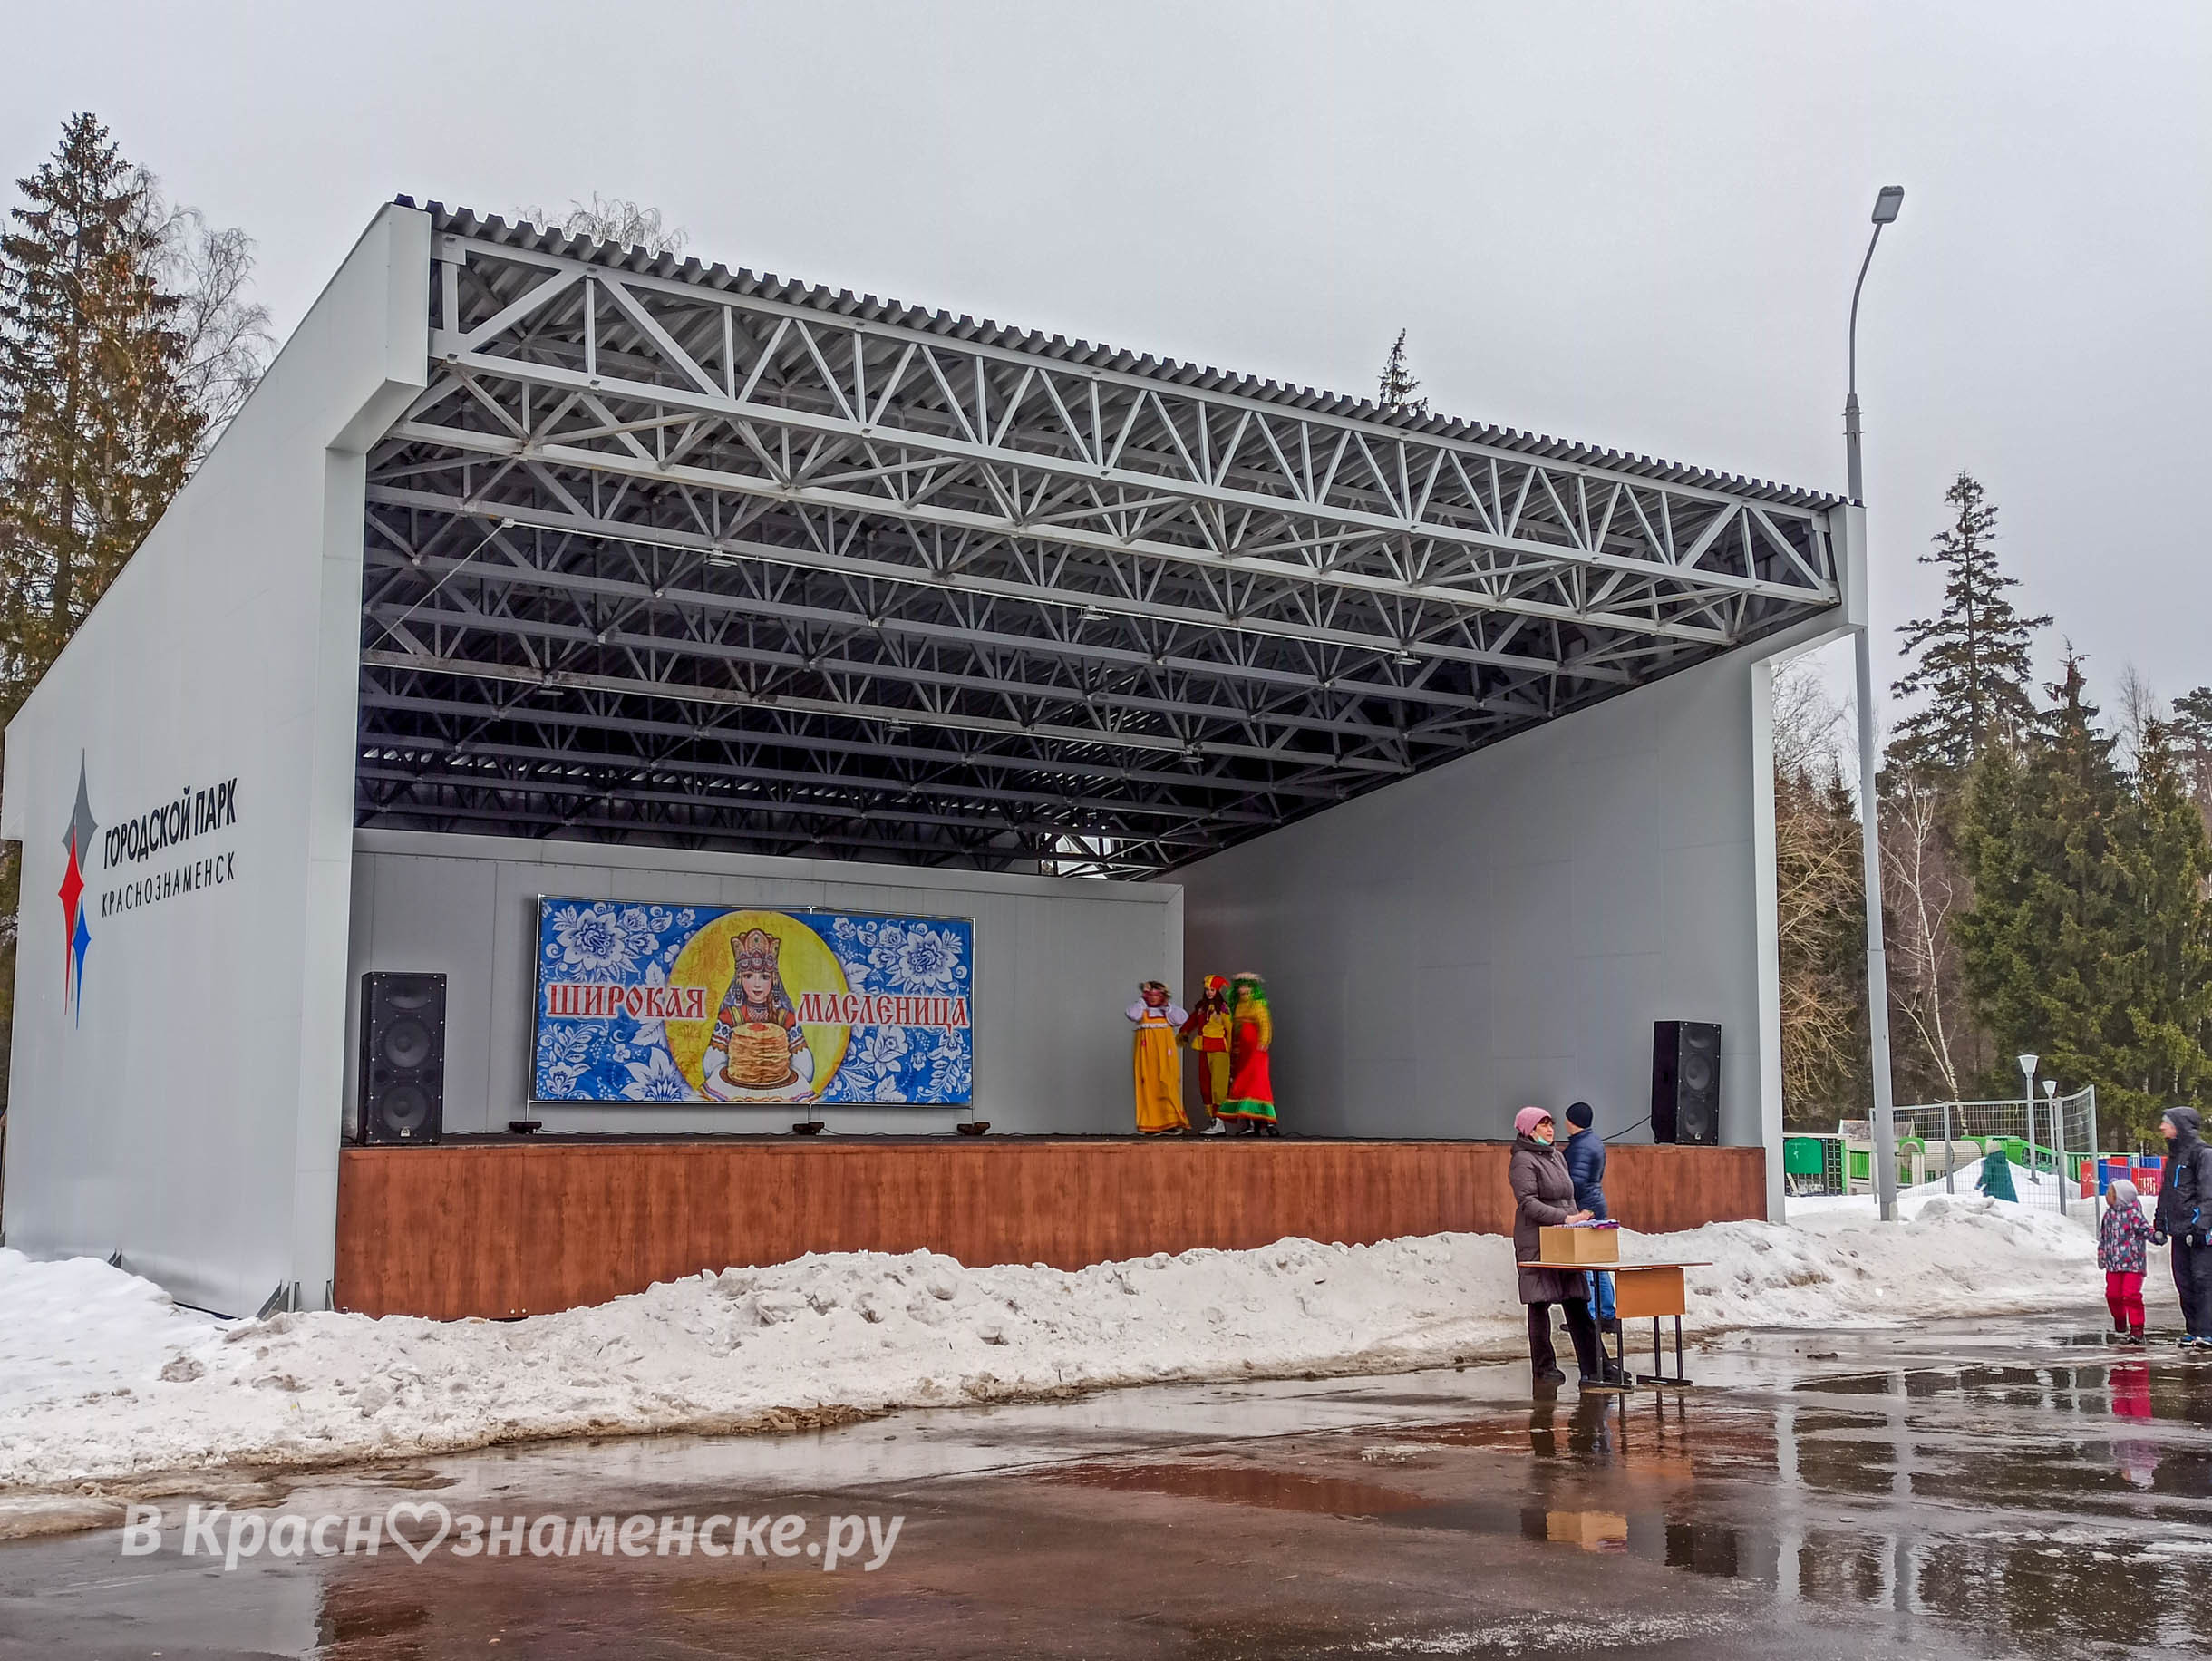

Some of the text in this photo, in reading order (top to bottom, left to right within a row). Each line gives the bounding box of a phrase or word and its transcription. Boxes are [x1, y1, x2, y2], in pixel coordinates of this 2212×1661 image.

[104, 777, 238, 869] ГОРОДСКОЙ ПАРК
[102, 851, 236, 918] КРАСНОЗНАМЕНСК
[548, 984, 968, 1035] ШИРОКАЯ МАСЛЕНИЦА
